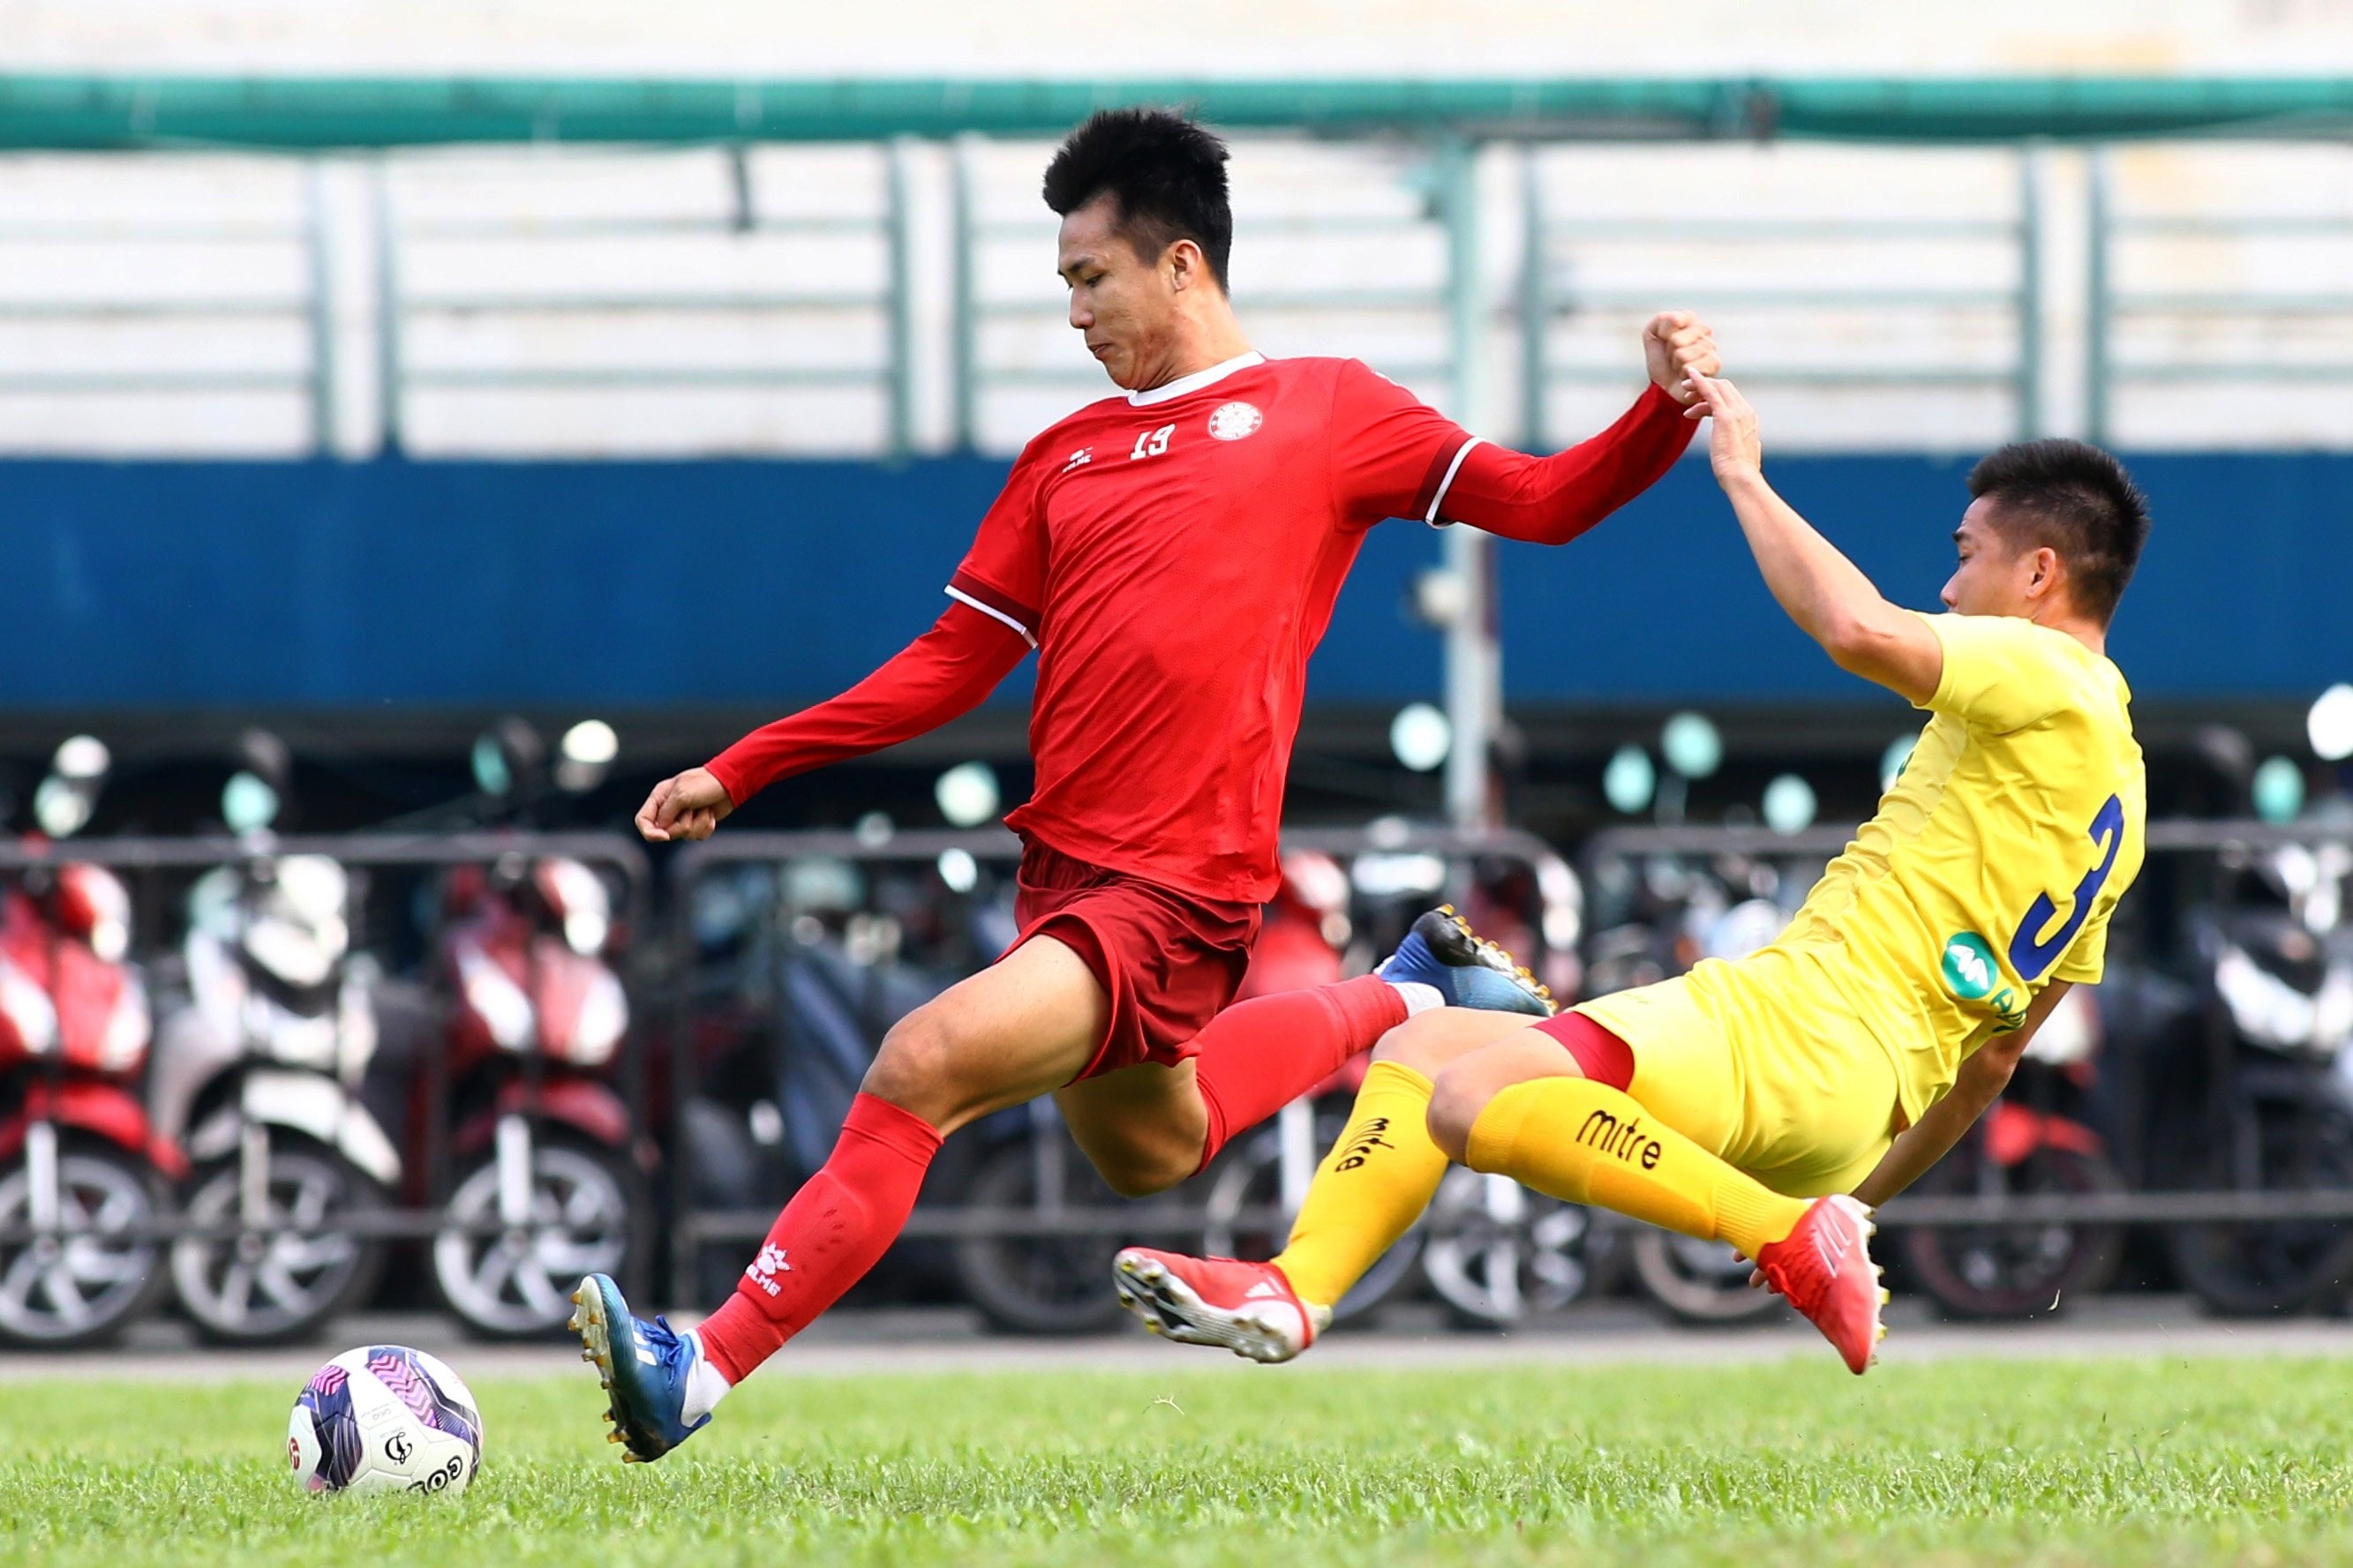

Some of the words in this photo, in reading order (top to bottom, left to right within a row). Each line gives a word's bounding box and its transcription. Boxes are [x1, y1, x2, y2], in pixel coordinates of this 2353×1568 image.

[1130, 423, 1176, 461] 19
[2008, 792, 2125, 982] 3
[1334, 1117, 1395, 1173] mitre
[1575, 1109, 1661, 1170] mitre
